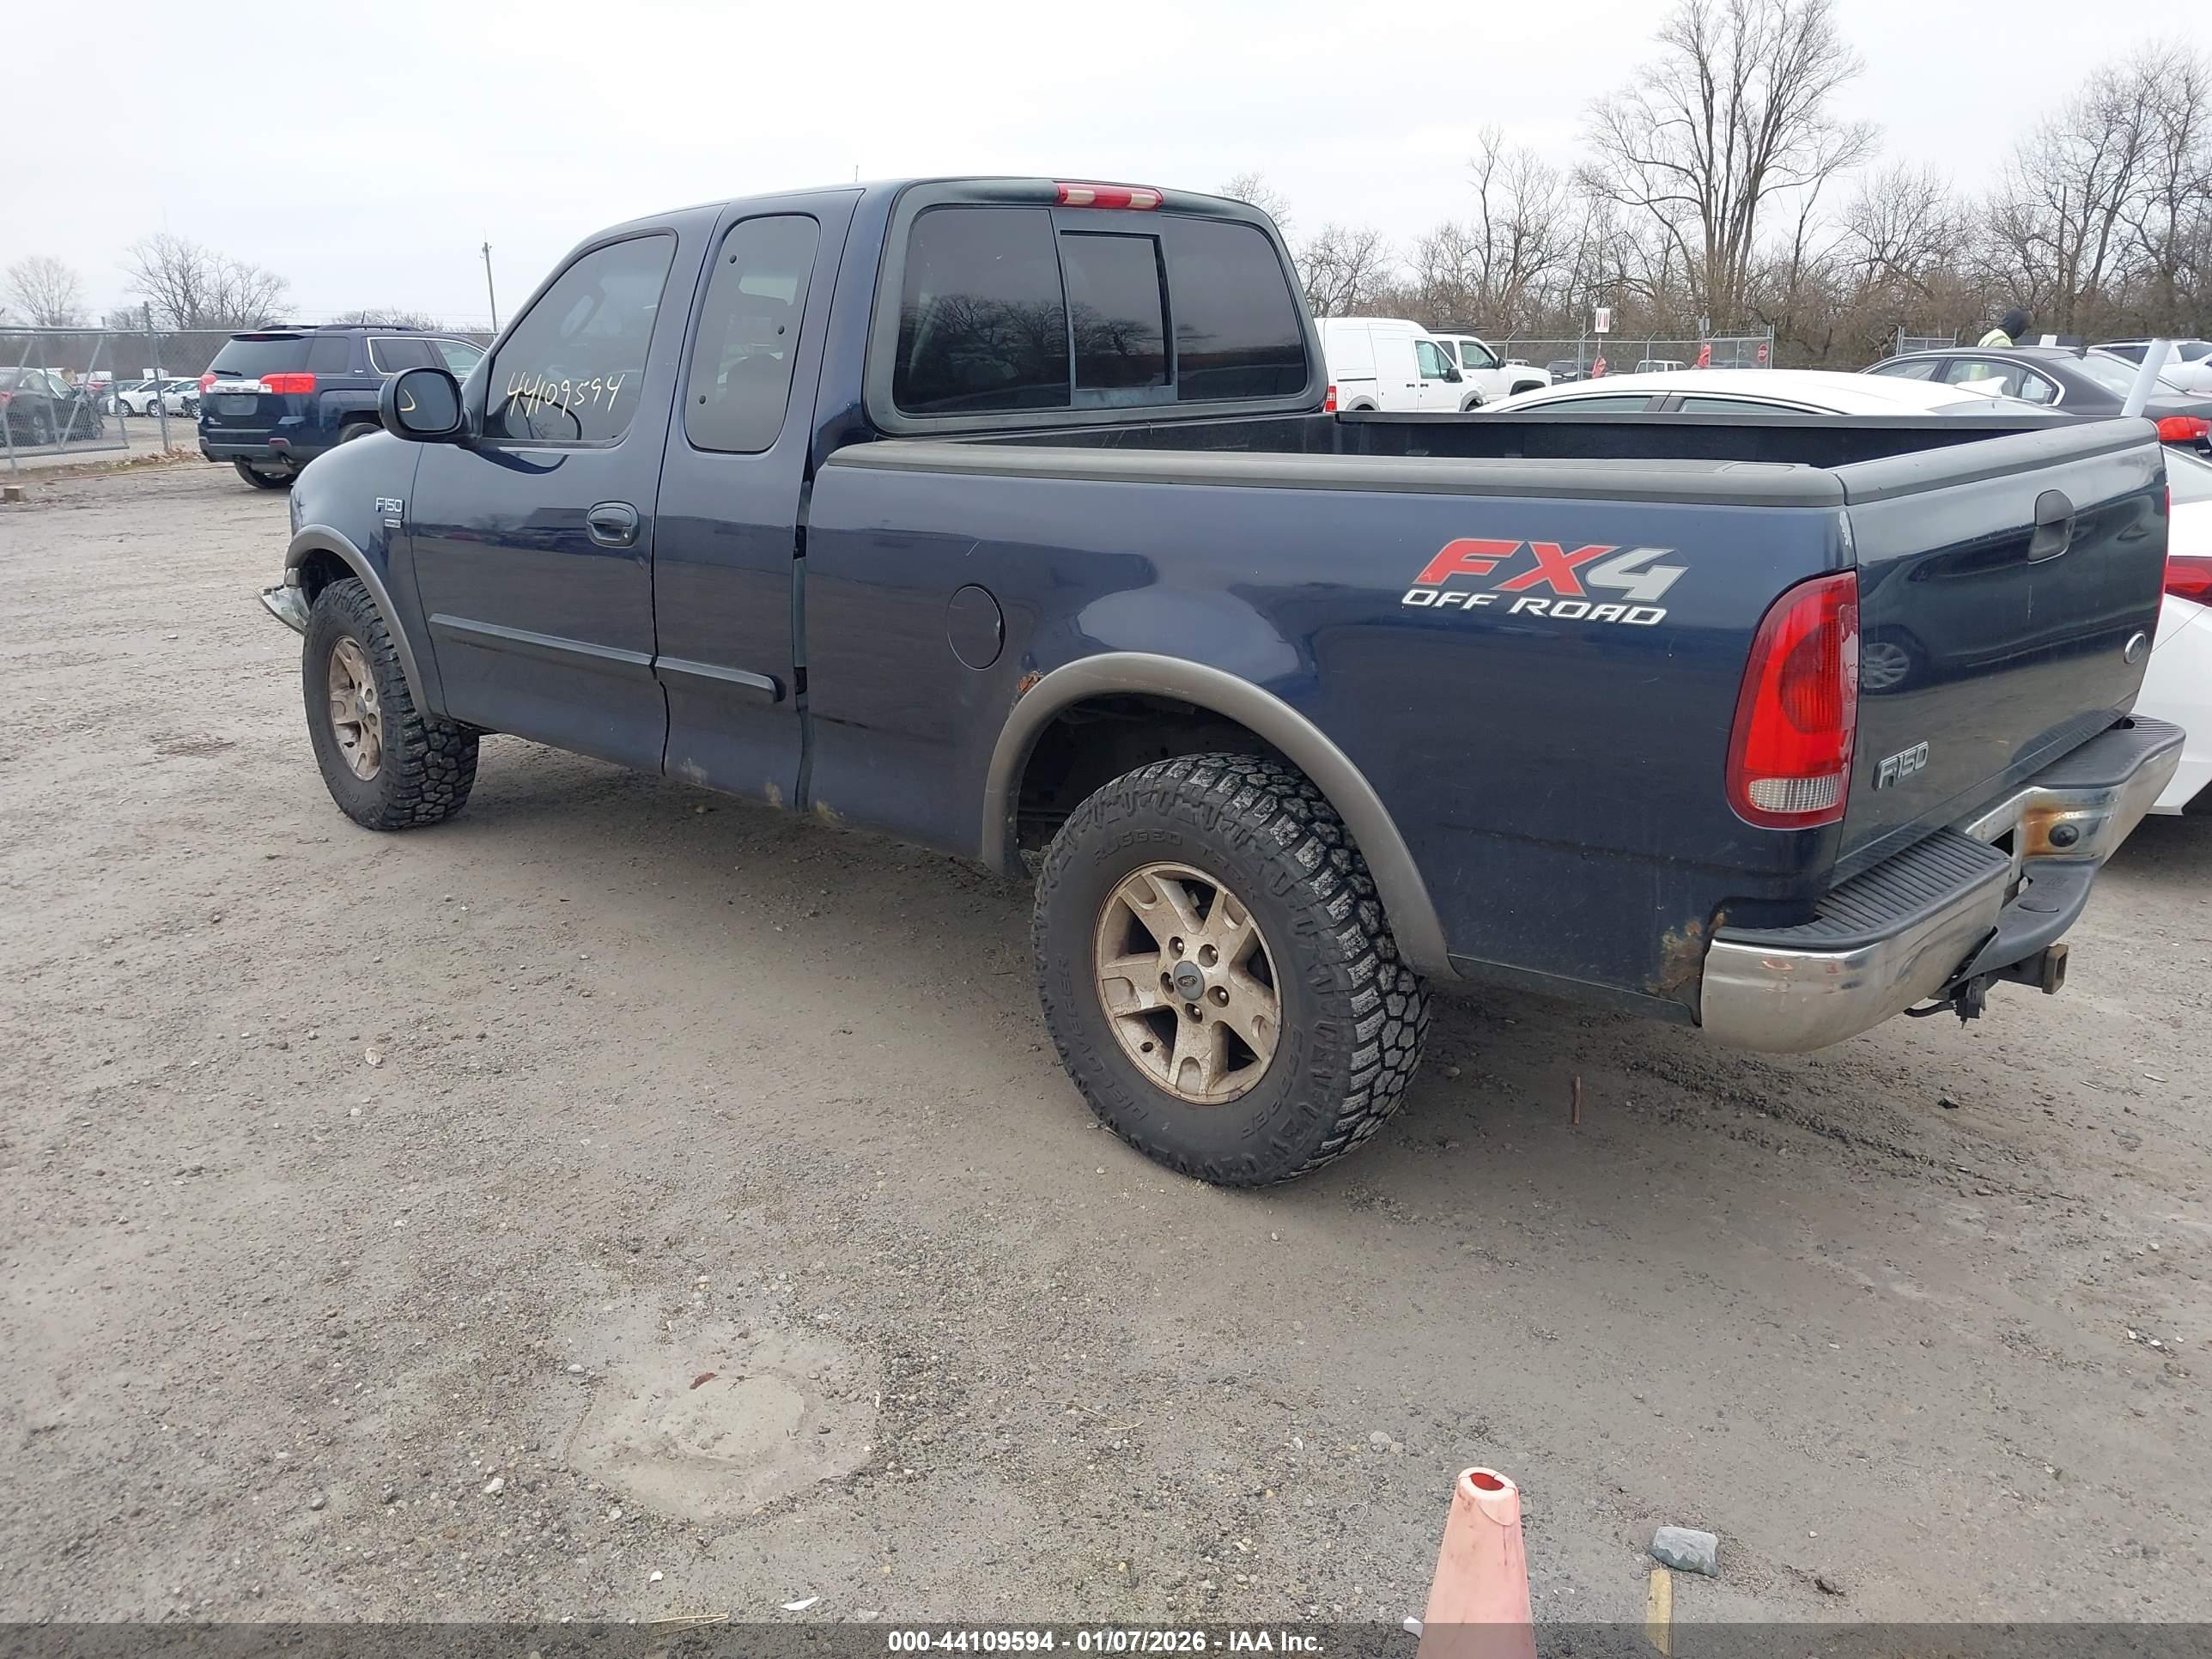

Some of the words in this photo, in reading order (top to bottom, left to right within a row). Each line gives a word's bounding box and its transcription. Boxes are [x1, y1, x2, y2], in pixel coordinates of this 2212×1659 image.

[507, 371, 626, 418] 44109594
[375, 497, 404, 513] F150
[1411, 538, 1690, 603] FX4
[1401, 588, 1500, 611] OFF
[1506, 596, 1668, 626] ROAD
[1875, 742, 1929, 790] F150
